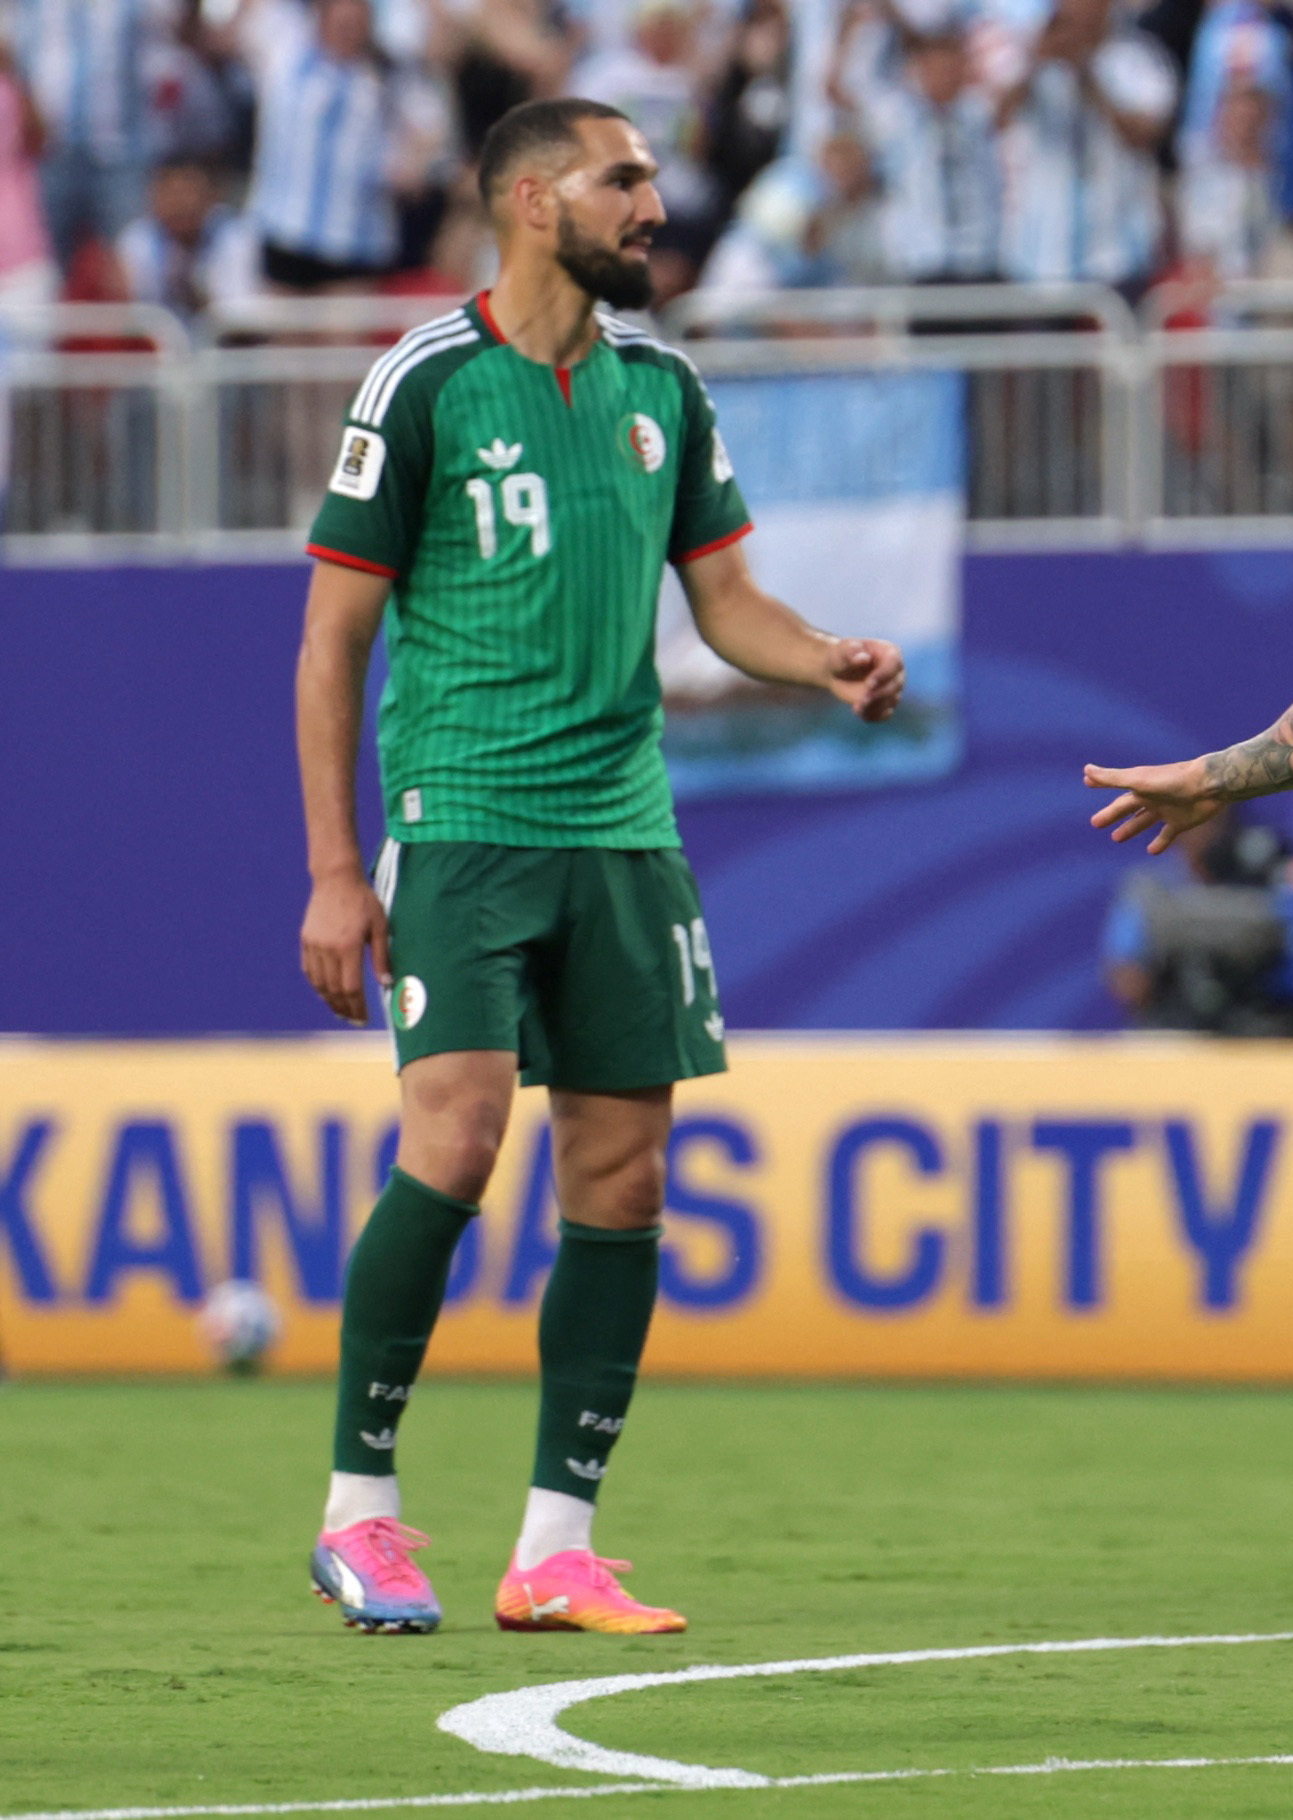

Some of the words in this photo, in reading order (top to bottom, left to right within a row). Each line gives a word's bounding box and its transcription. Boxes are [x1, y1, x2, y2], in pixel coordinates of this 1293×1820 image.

[466, 472, 550, 560] 19
[672, 917, 719, 1008] 19
[823, 1112, 1282, 1314] CITY
